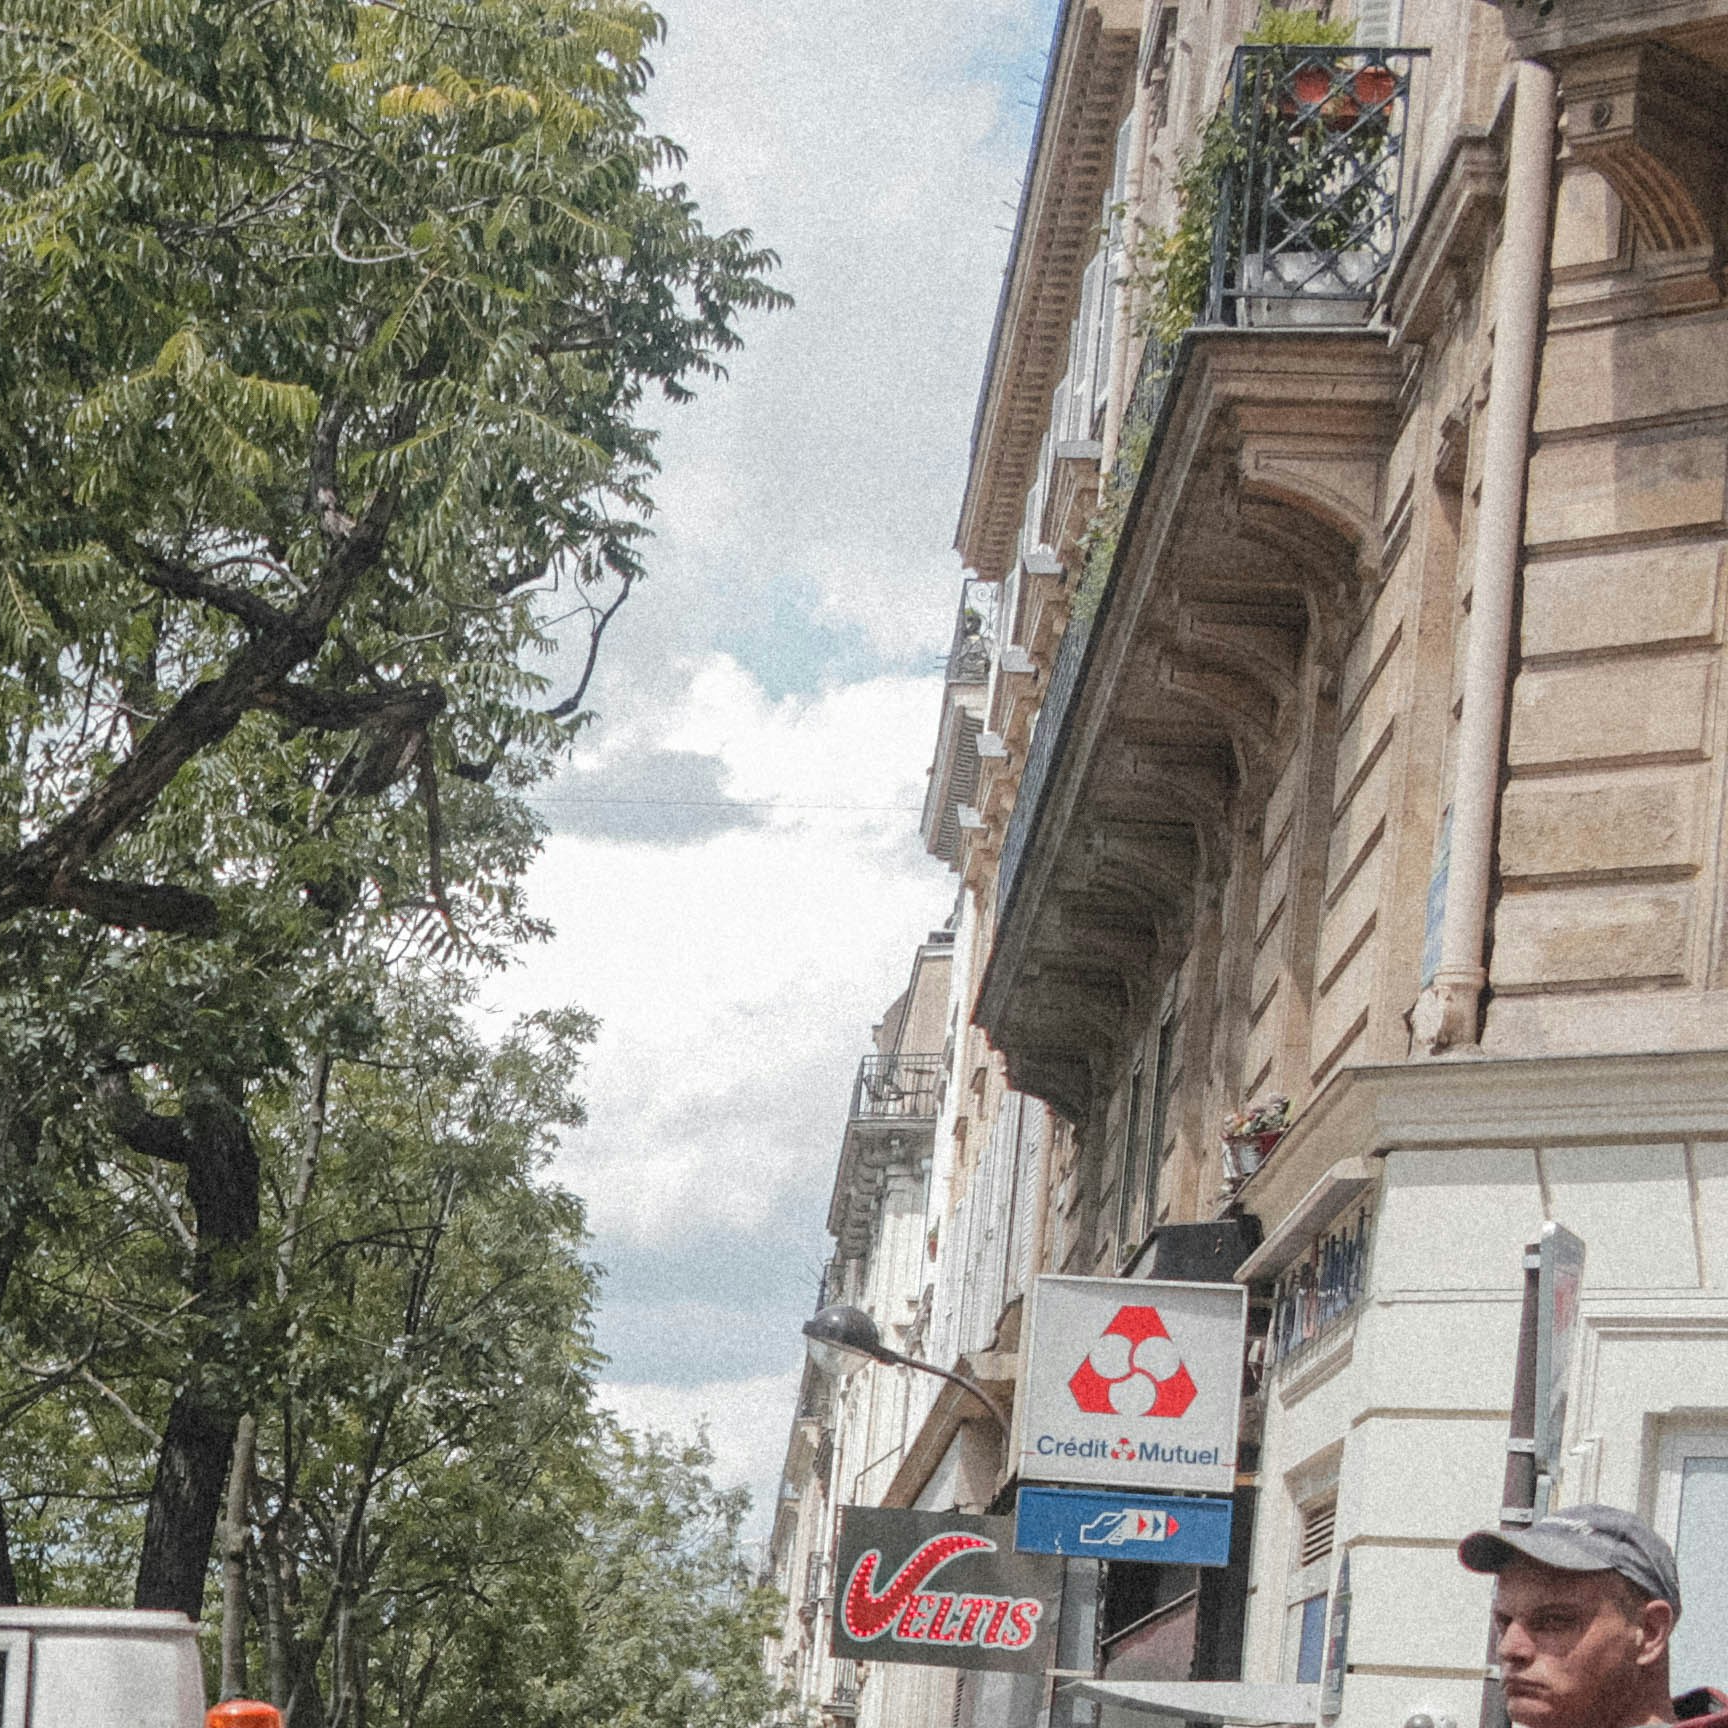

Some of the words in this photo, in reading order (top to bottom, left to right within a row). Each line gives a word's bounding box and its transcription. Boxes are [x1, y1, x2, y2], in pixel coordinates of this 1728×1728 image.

[1036, 1434, 1109, 1459] Crédit
[1138, 1442, 1219, 1465] Mutuel
[842, 1532, 1043, 1649] VELTIS
